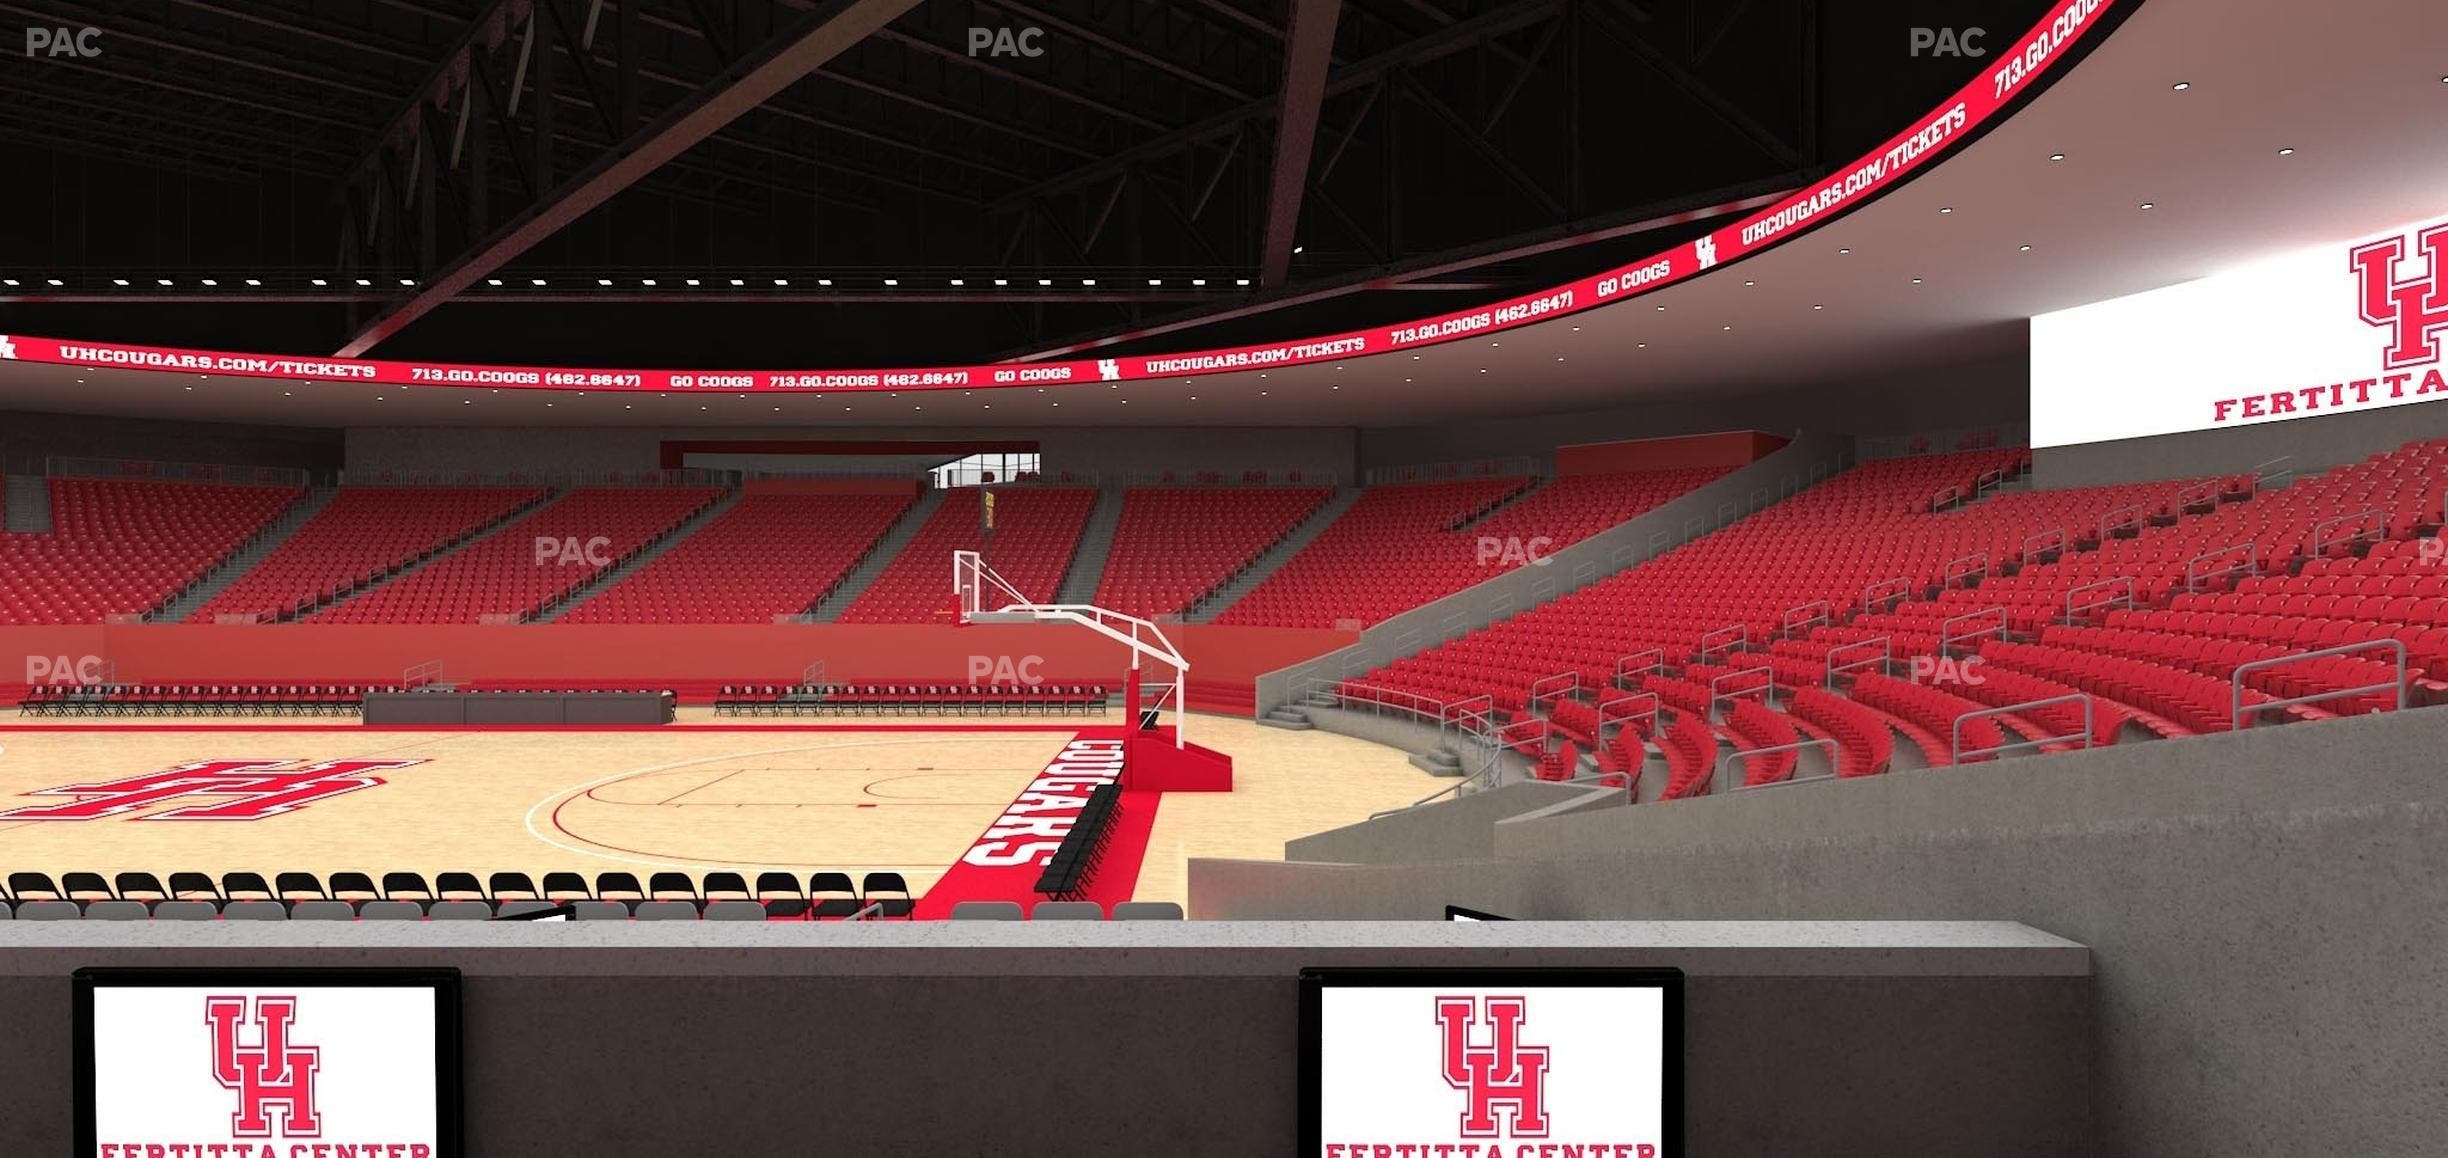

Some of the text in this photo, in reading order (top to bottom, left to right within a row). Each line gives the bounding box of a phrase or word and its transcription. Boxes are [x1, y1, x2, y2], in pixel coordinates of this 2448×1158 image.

[1741, 102, 1967, 245] UHCOUGARS.COM/TICKETS
[1597, 260, 1670, 297] GO COOGS
[1391, 290, 1573, 345] 713.GO.COOGS (462.6647)
[59, 345, 377, 379] UHCOUGARS.COM/TICKETS
[1146, 337, 1365, 374] UHCOUGARS.COM/TICKETS
[412, 368, 539, 384] 713.GO.COOGS
[670, 374, 754, 388] GO COOGS
[769, 374, 878, 388] 713.GO.COOGS
[994, 367, 1072, 382] GO COOGS
[2213, 369, 2448, 422] FERTITTA
[206, 996, 321, 1138] UH
[1435, 996, 1550, 1138] UH
